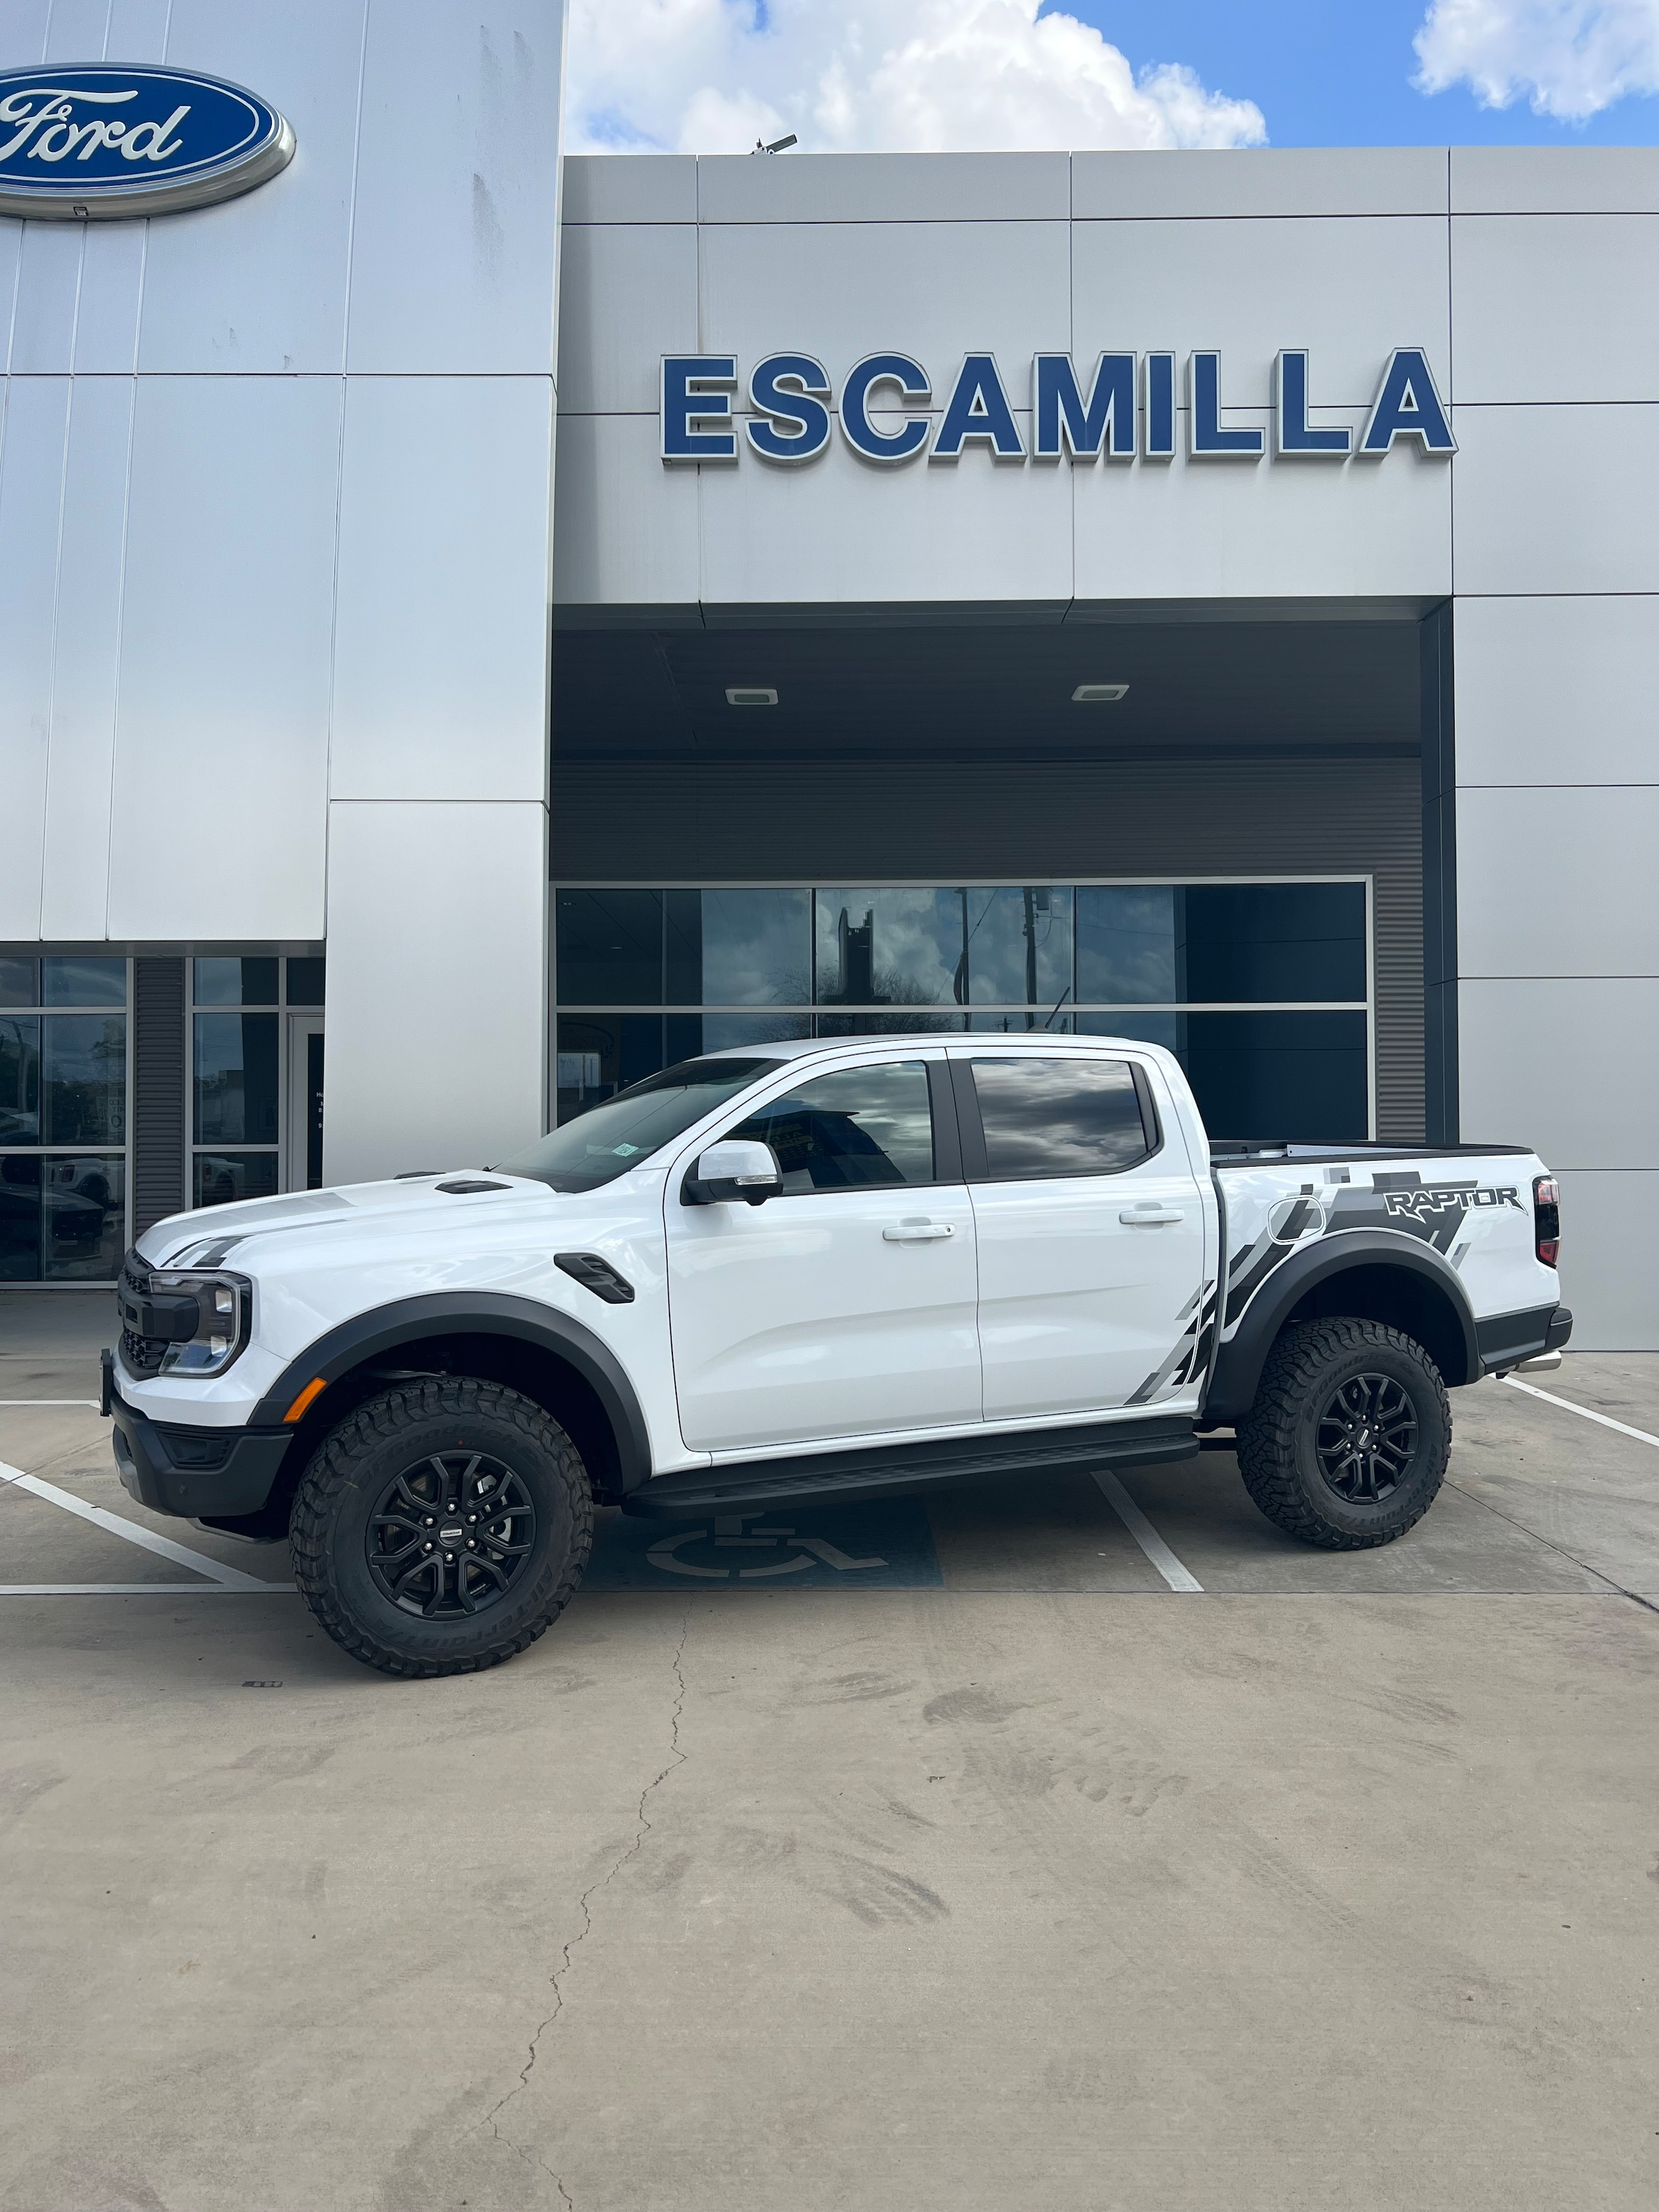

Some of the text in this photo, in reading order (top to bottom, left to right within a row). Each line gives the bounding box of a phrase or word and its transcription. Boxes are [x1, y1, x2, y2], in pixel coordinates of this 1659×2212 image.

[0, 89, 192, 163] Ford
[660, 346, 1459, 463] ESCAMILLA
[1383, 1185, 1528, 1224] RAPTOR
